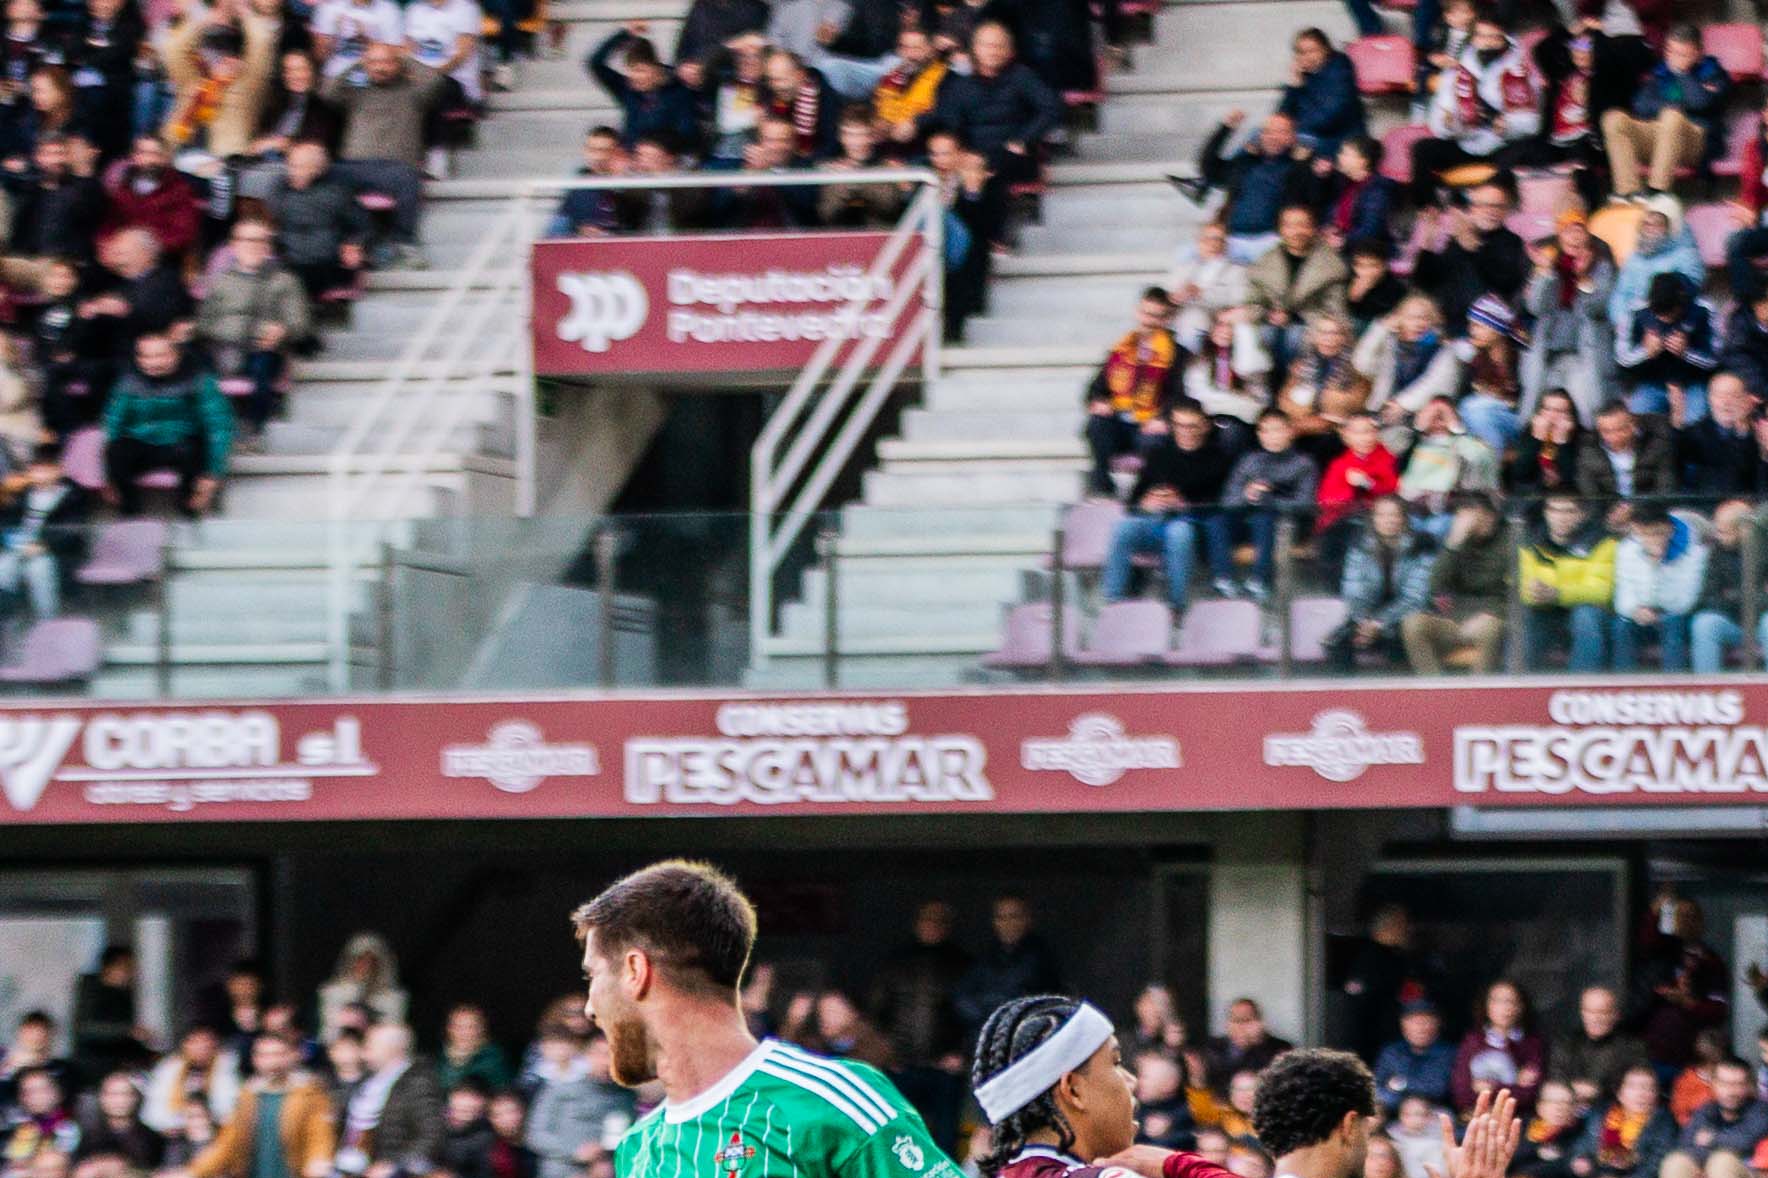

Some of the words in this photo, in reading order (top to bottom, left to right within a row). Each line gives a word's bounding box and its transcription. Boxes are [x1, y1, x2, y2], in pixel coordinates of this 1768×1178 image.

[1549, 690, 1744, 726] CONSERVAS
[84, 711, 281, 769] CORBA
[624, 735, 994, 804] PESCAMAR
